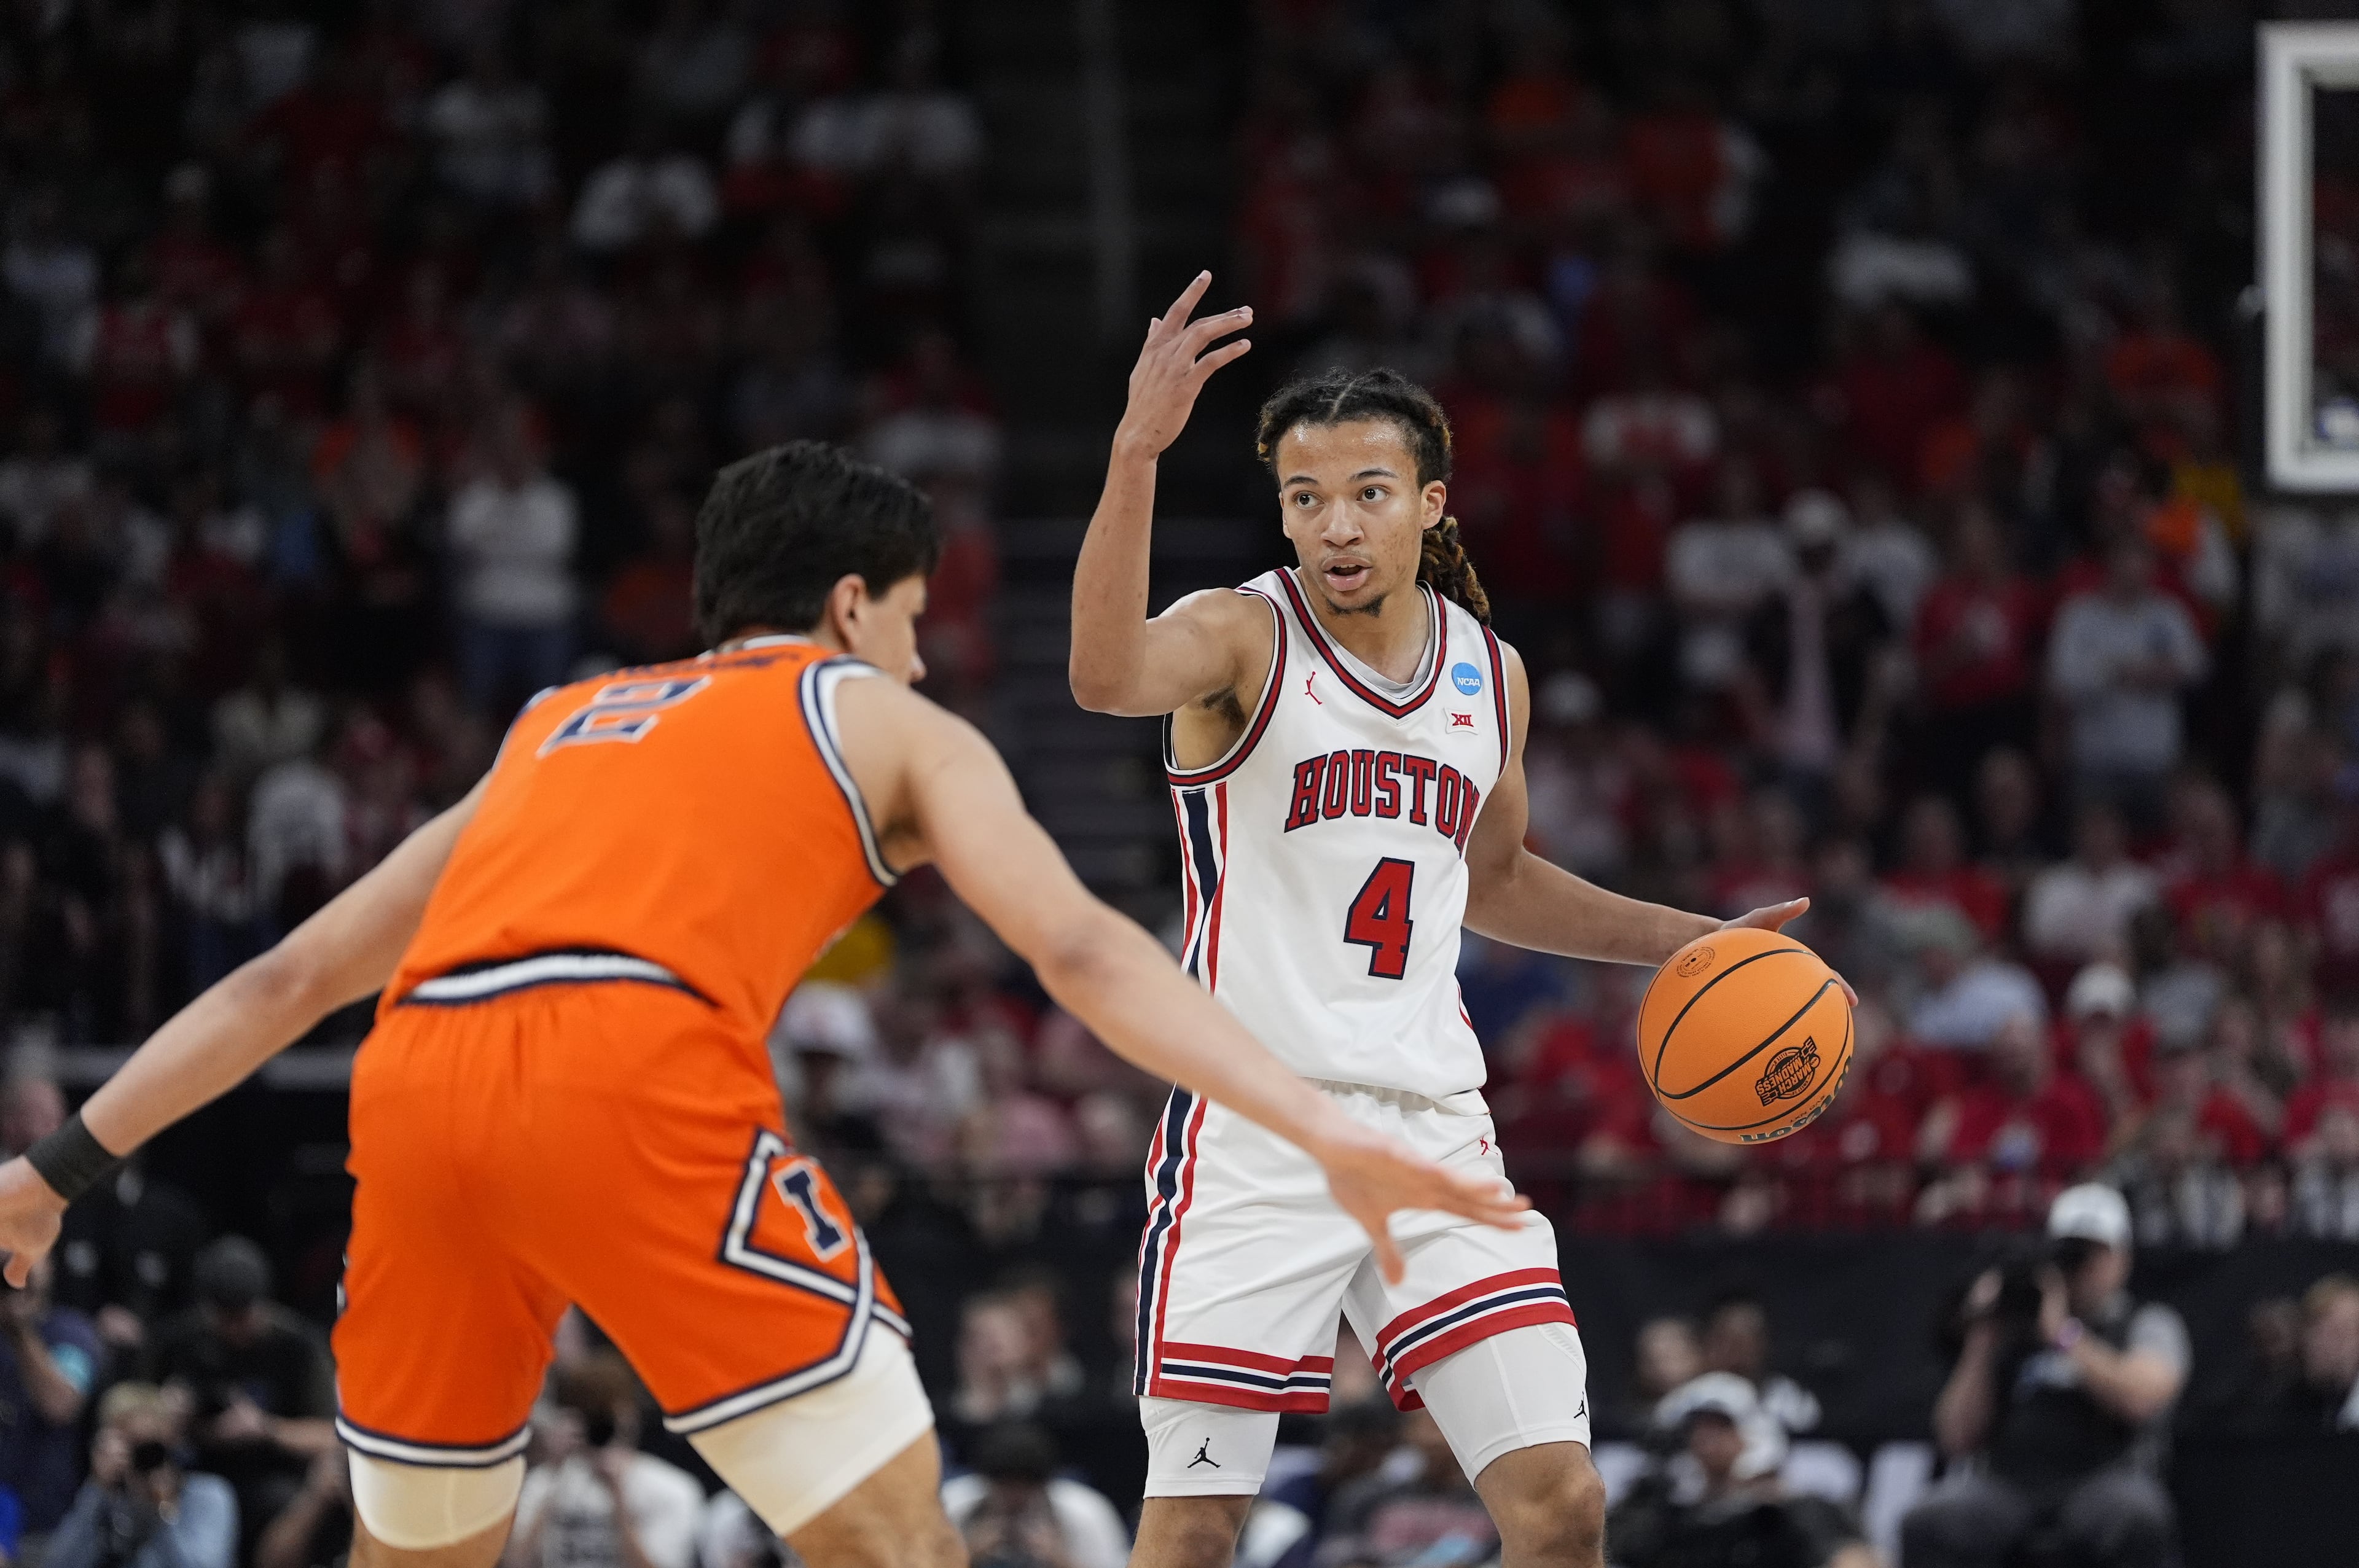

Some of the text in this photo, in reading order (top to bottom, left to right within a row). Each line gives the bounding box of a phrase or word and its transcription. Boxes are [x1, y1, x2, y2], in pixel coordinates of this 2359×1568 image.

[1457, 677, 1481, 687] NCAA
[534, 674, 712, 759] 2
[1451, 712, 1474, 727] XII
[1284, 749, 1480, 859] HOUSTON
[1343, 857, 1415, 980] 4
[1756, 1056, 1803, 1095] MADNESS
[1778, 1062, 1812, 1094] MARCH
